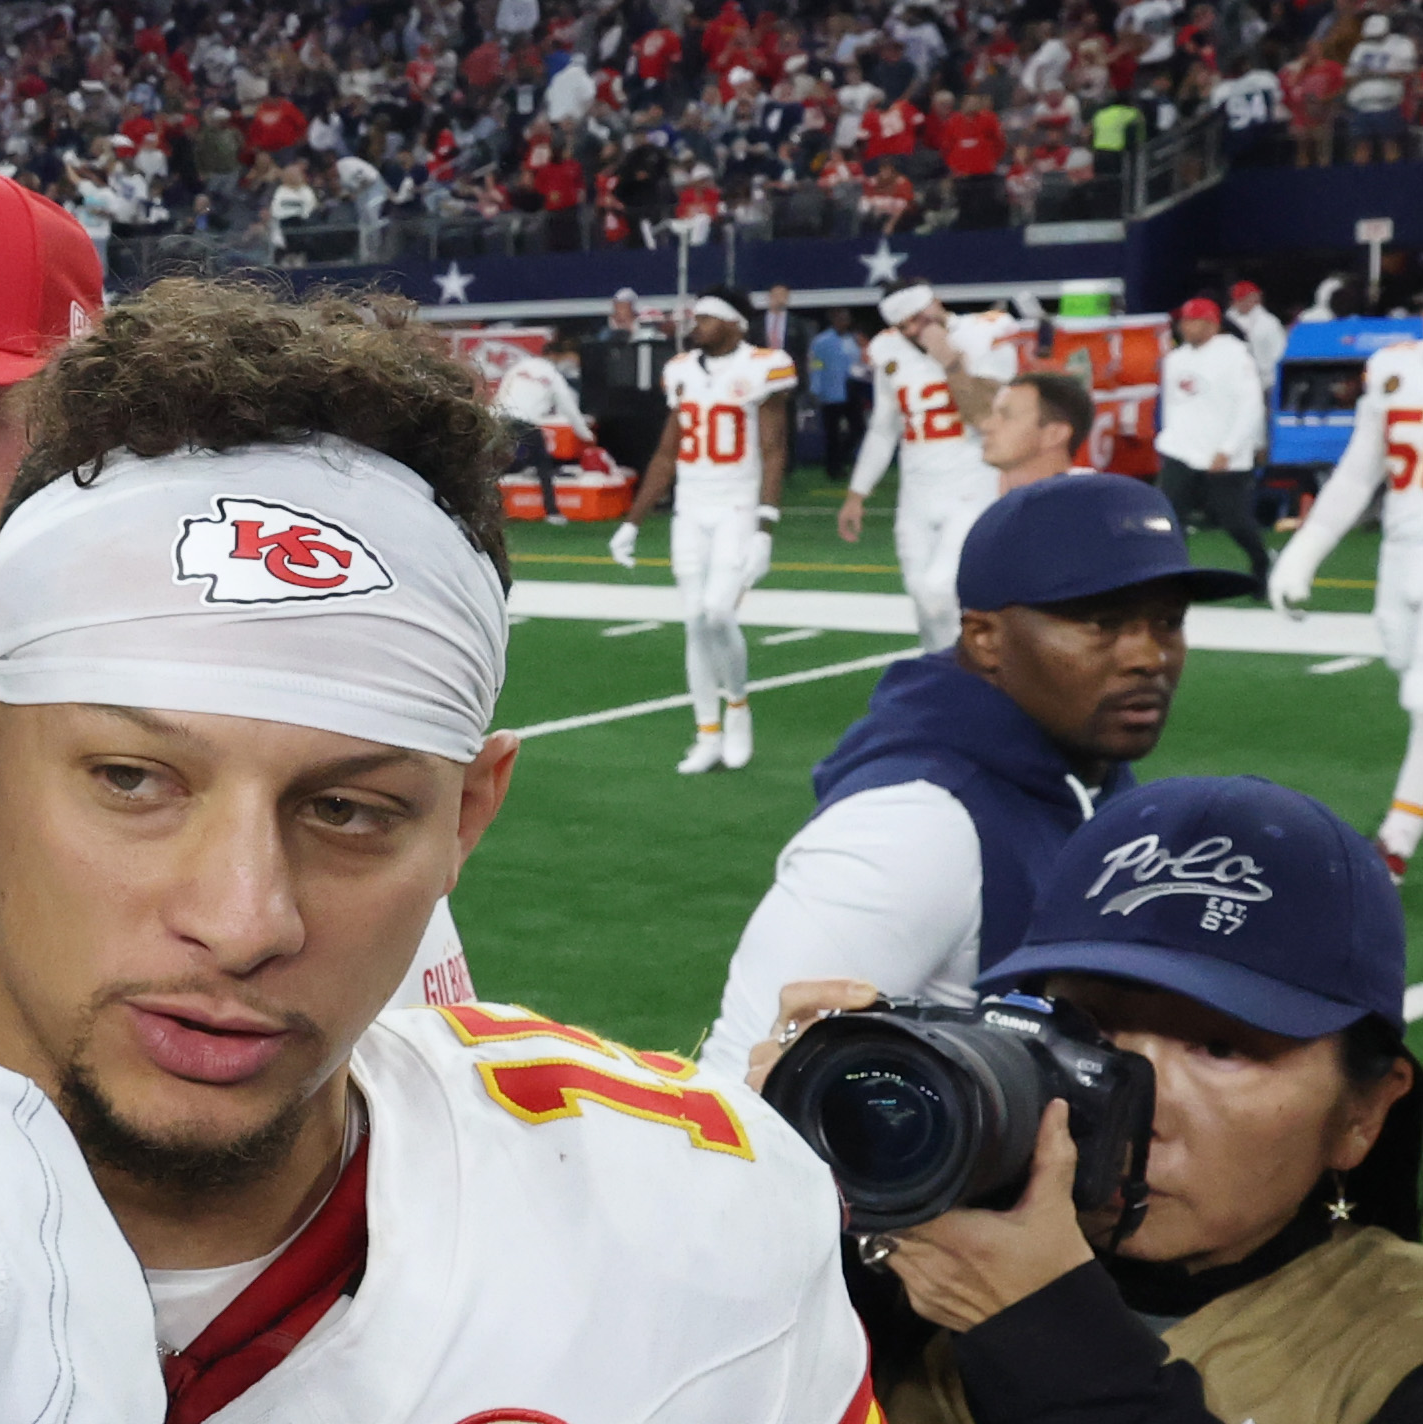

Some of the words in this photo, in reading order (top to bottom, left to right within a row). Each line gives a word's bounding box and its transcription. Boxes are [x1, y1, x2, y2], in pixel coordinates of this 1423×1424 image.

[229, 519, 353, 589] KC
[1084, 833, 1264, 900] Polo
[1199, 910, 1246, 936] 67
[984, 1009, 1042, 1035] Canon
